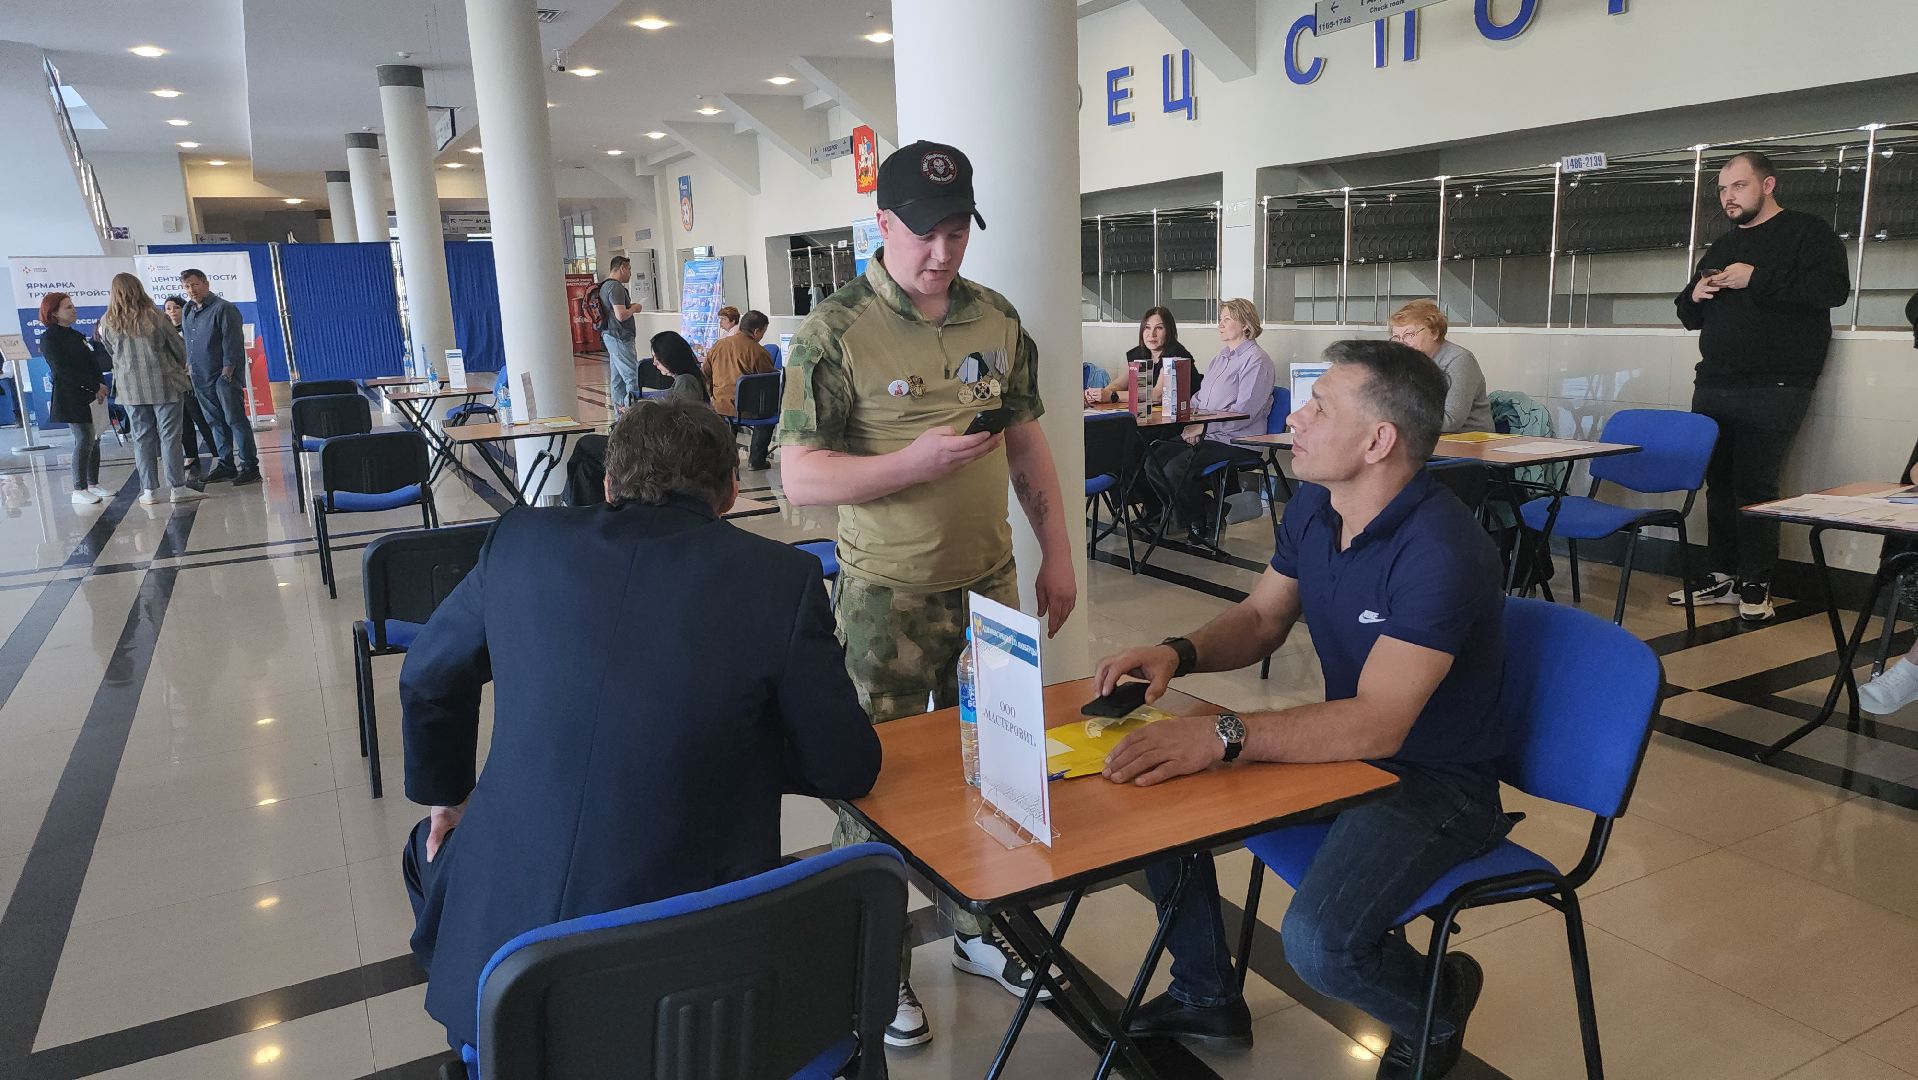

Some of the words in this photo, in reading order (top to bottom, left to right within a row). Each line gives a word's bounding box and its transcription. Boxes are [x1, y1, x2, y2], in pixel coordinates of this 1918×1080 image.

[1369, 4, 1389, 14] Check
[26, 282, 76, 291] ЯРМАРКА
[999, 700, 1016, 719] ООО
